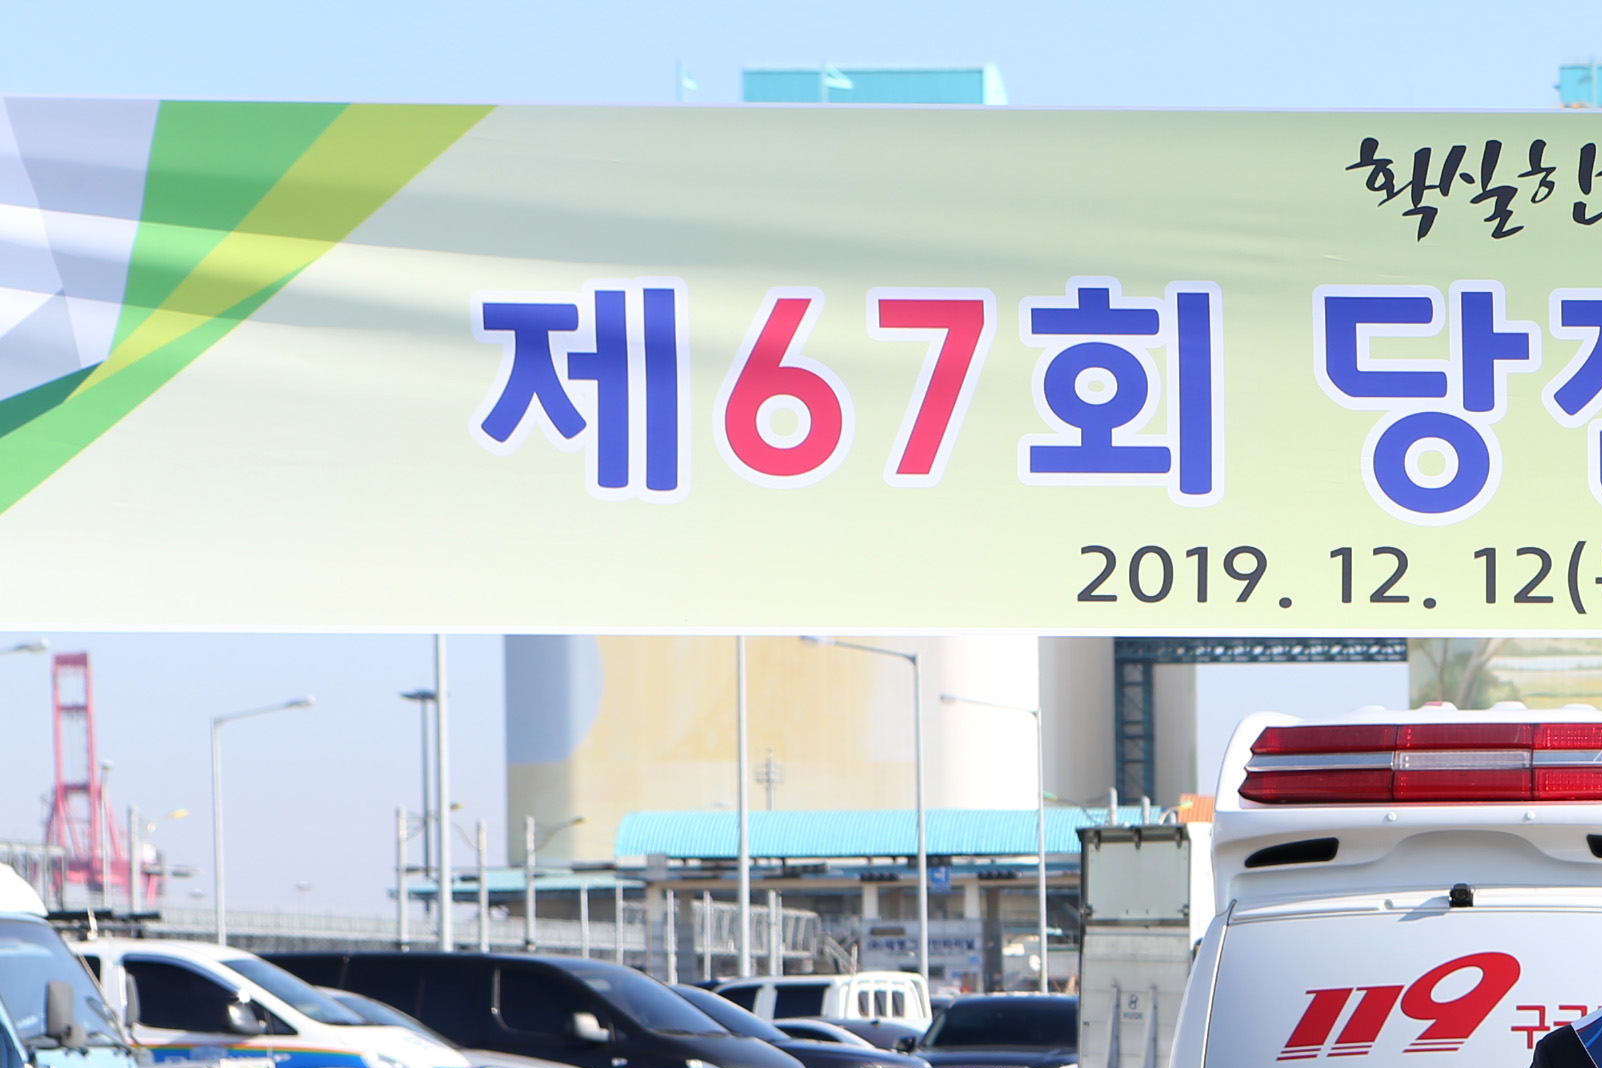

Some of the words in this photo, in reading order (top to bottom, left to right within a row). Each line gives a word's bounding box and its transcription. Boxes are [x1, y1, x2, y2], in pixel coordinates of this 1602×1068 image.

[479, 285, 1214, 497] 제67회
[1077, 545, 1292, 608] 2019.
[1330, 546, 1437, 609] 12.
[1277, 952, 1521, 1060] 119
